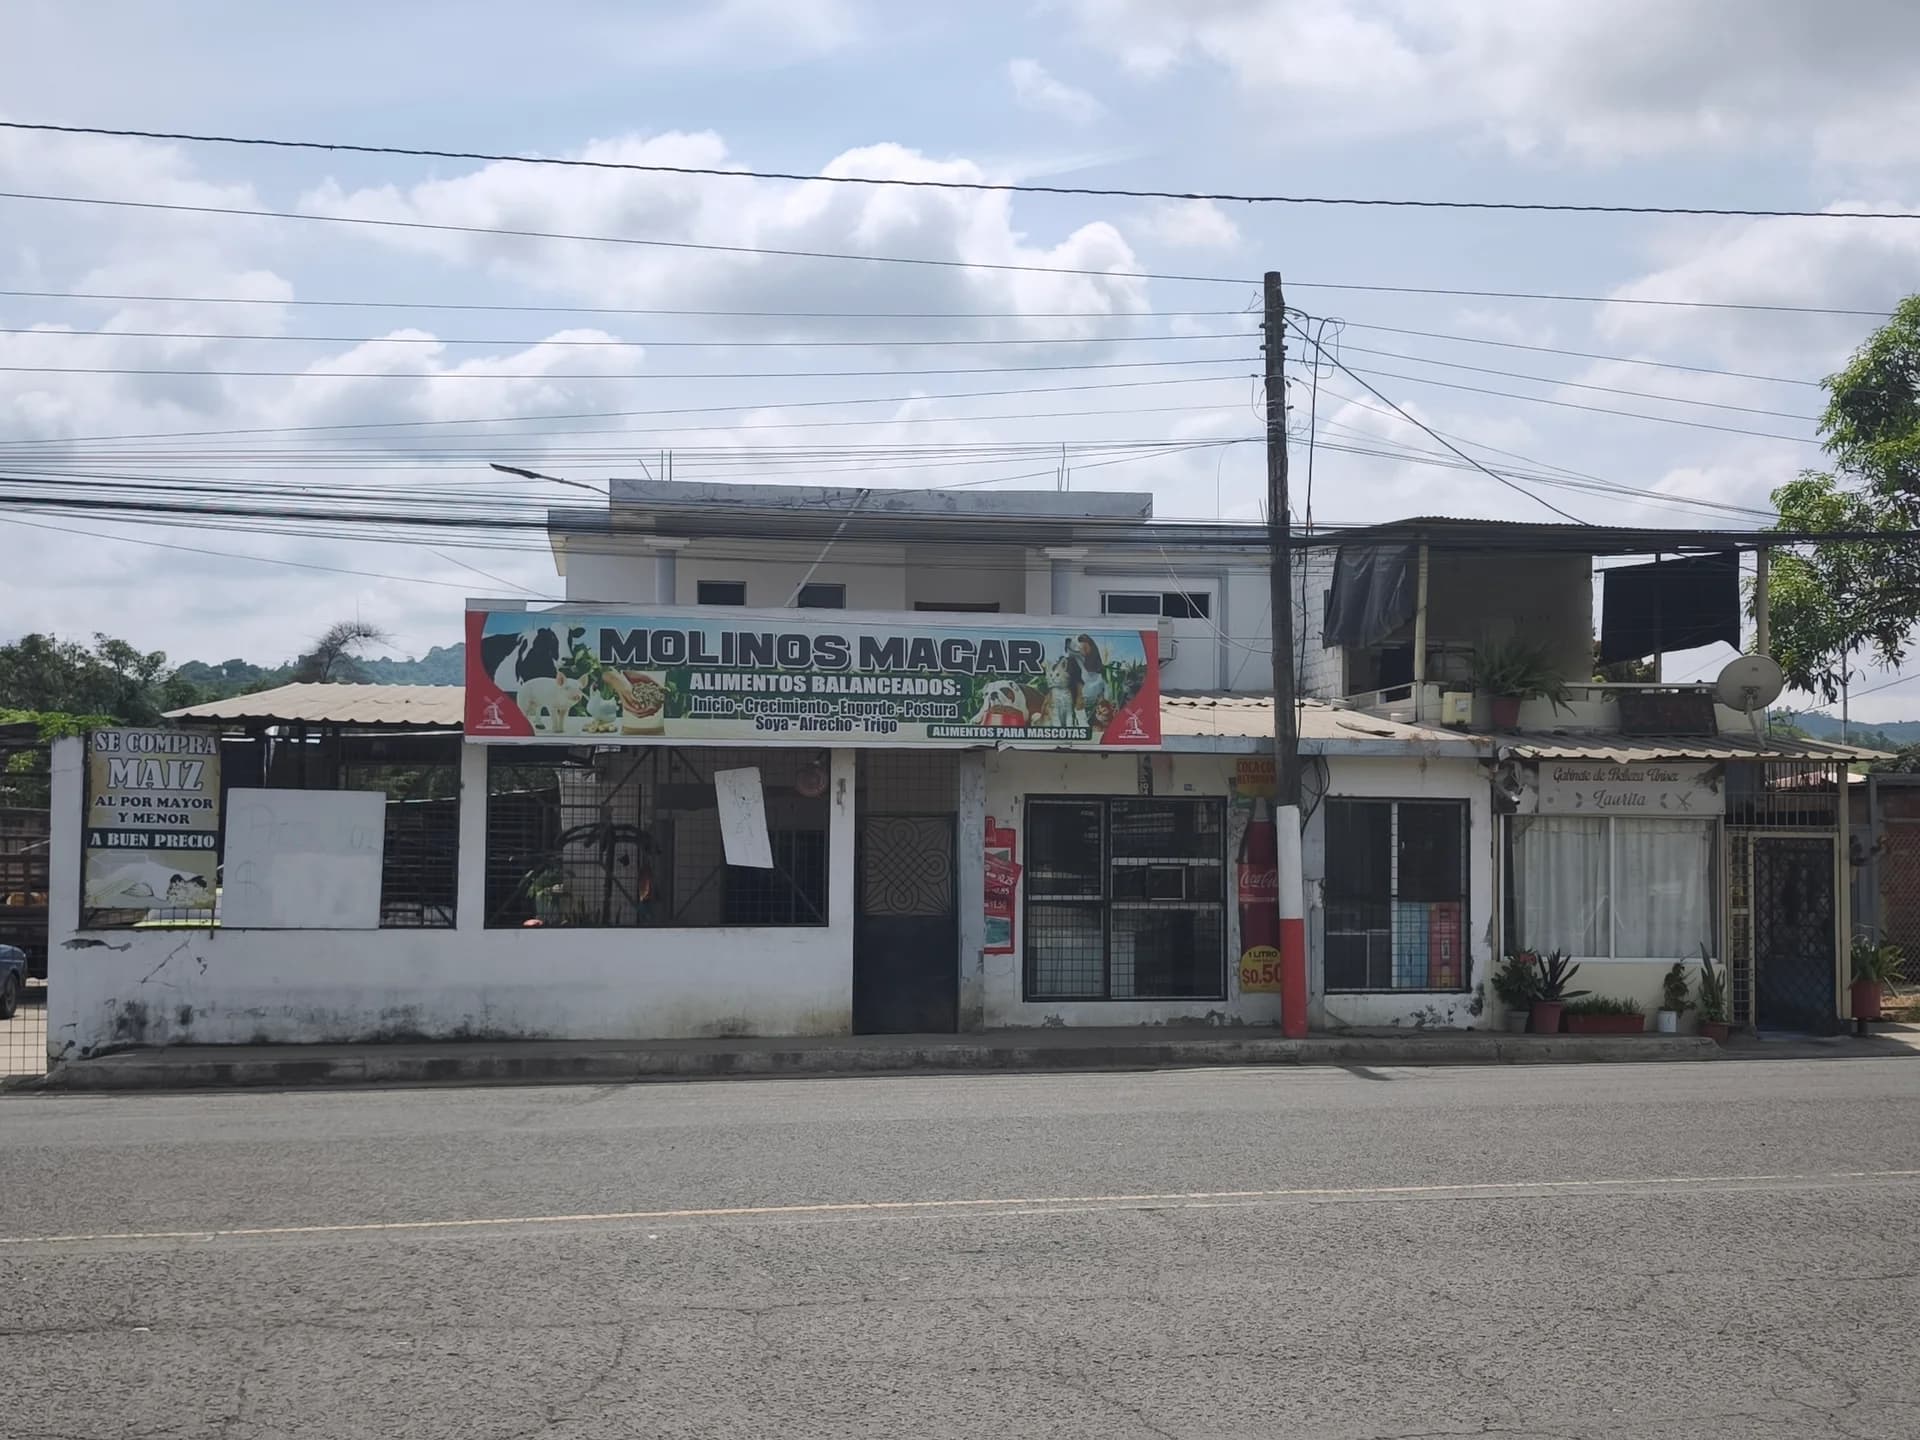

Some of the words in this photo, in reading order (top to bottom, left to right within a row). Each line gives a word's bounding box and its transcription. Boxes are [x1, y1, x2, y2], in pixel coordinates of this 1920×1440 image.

[599, 627, 851, 671] MOLINOS
[859, 634, 1046, 675] MAGAR
[689, 672, 807, 693] ALIMENTOS
[811, 676, 962, 697] BALANCEADOS:
[693, 696, 734, 714] Inicio
[744, 697, 830, 715] Crecimiento
[840, 700, 895, 718] Engorde
[905, 701, 958, 718] Postura
[755, 716, 789, 733] Soya
[799, 717, 852, 732] Afrecho
[863, 717, 897, 734] Trigo
[932, 726, 994, 737] ALIMENTOS
[996, 727, 1026, 738] PARA
[1027, 728, 1087, 739] MASCOTAS
[95, 732, 120, 752] SE
[126, 733, 217, 754] COMPRA
[107, 758, 205, 791] MAIZ
[1553, 767, 1591, 782] Gabinete
[1593, 768, 1606, 781] de
[1608, 767, 1644, 781] Belleza
[95, 796, 116, 807] AL
[121, 796, 152, 808] POR
[156, 797, 213, 809] MAYOR
[1592, 789, 1647, 808] Laurita
[118, 812, 128, 823] Y
[133, 812, 190, 824] MENOR
[91, 833, 101, 845] A
[108, 833, 149, 847] BUEN
[154, 834, 215, 848] PRECIO
[1254, 950, 1278, 958] LITRO
